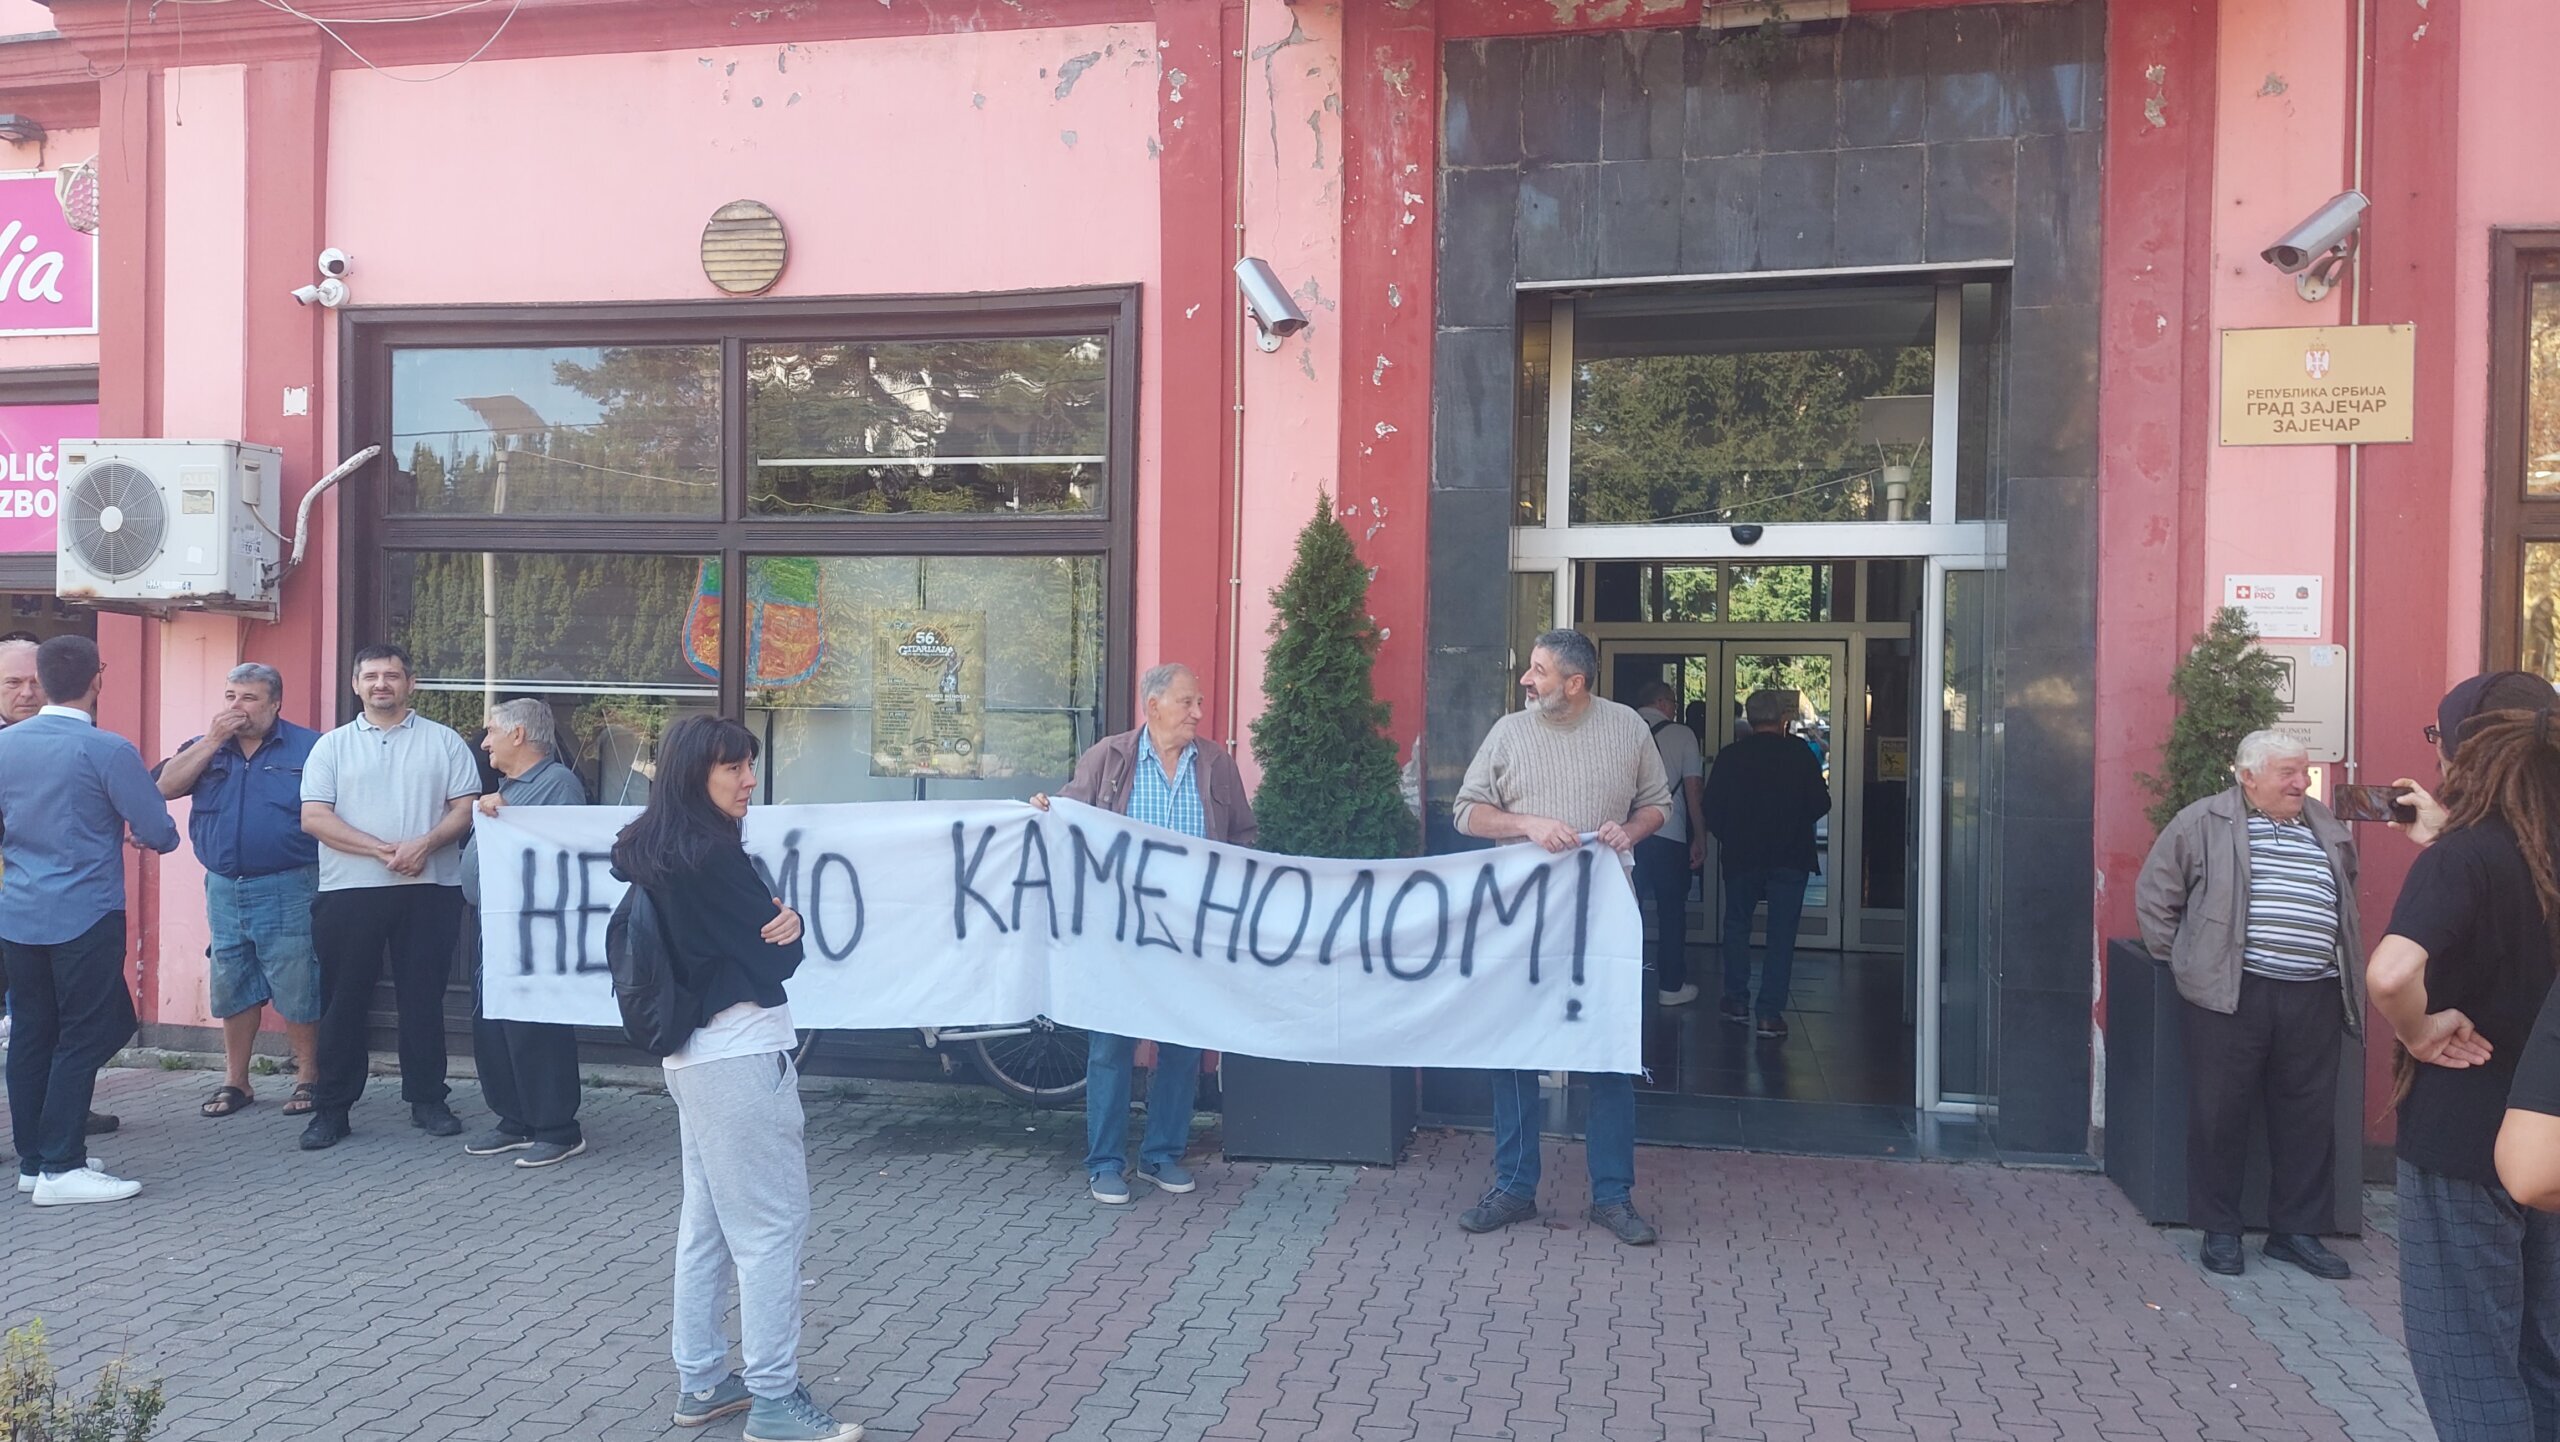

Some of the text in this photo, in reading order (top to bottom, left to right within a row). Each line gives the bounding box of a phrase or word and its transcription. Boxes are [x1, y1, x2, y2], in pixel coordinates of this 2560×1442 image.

[2247, 386, 2386, 399] РЕПУБЛИКА СРБИЈА
[2246, 399, 2387, 417] ГРАД ЗАЈЕЧАР
[2273, 417, 2361, 433] ЗАЈЕЧАР
[0, 445, 58, 481] LIČ
[2254, 592, 2276, 600] PRO
[915, 631, 939, 645] 56.
[898, 645, 954, 657] GITARIJADA
[951, 819, 1594, 1021] КАМЕНОЛОМ!
